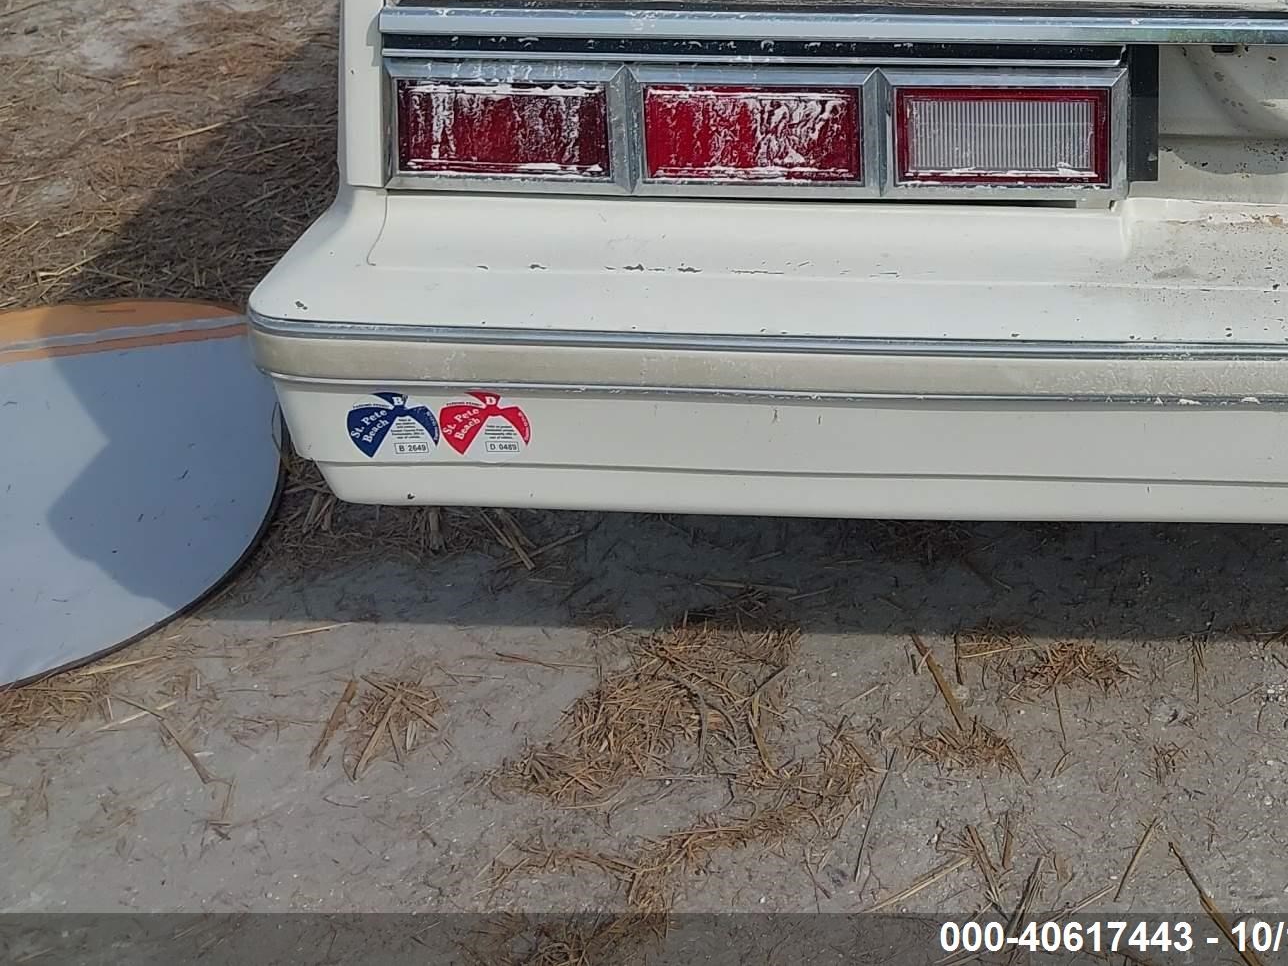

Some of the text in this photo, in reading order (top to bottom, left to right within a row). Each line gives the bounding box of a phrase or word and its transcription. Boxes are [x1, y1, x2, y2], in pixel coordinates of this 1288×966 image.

[392, 396, 404, 405] B
[485, 396, 497, 405] D
[361, 409, 388, 426] Pete
[454, 408, 480, 423] Pete
[361, 418, 390, 443] Beach
[454, 417, 481, 440] Beach
